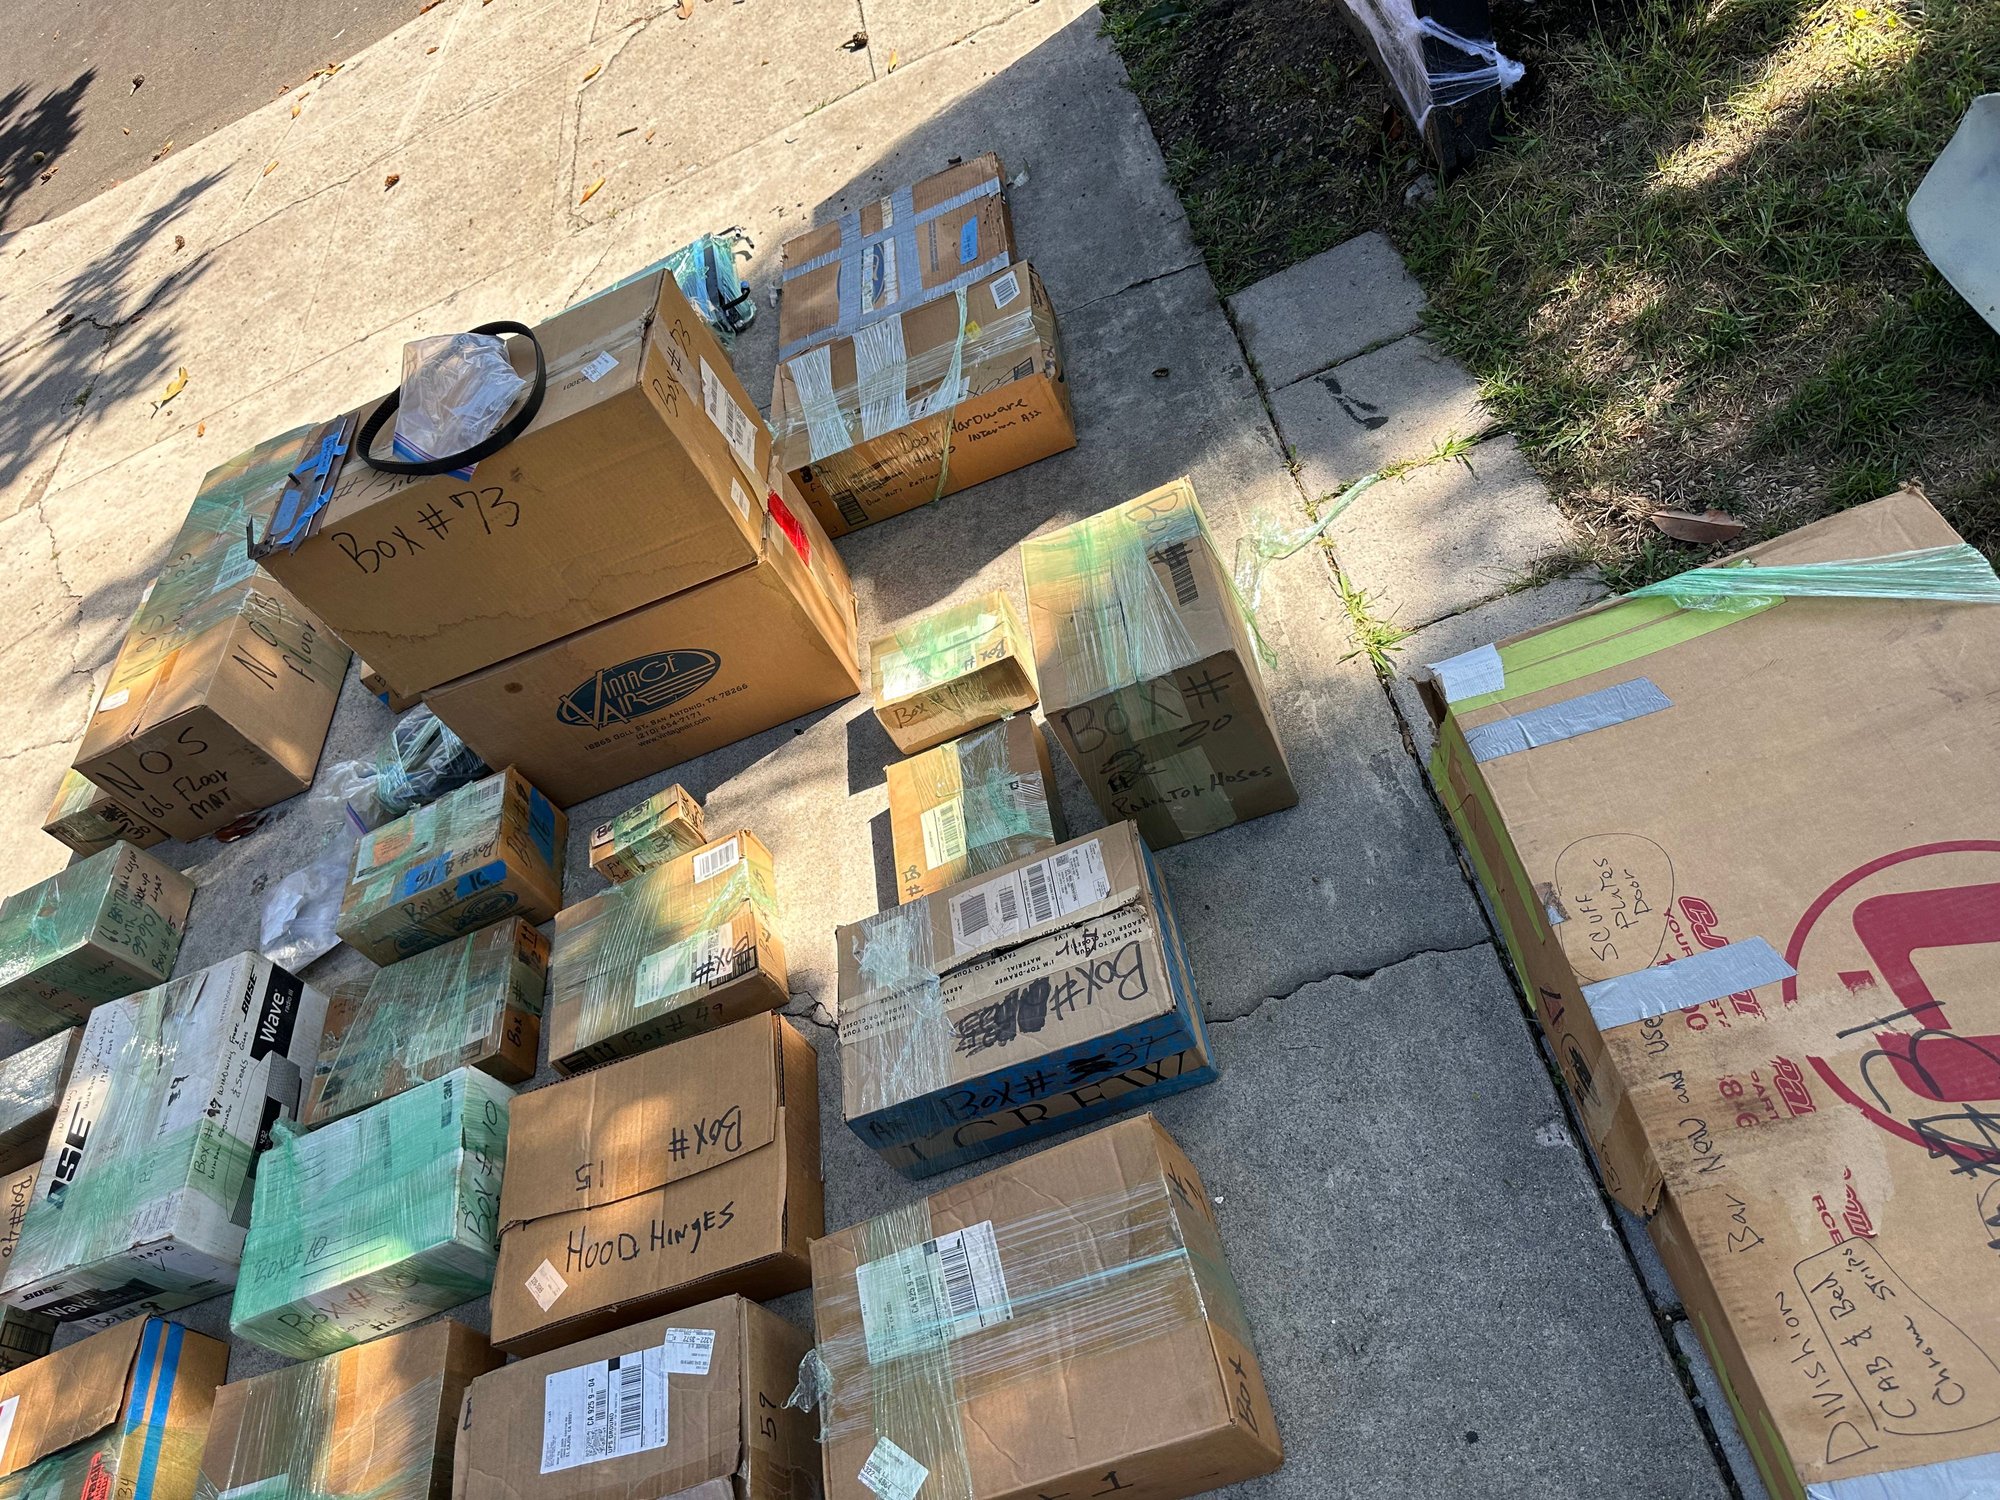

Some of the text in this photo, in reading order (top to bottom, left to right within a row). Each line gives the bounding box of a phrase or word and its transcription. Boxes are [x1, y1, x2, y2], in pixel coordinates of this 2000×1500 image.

[332, 487, 520, 573] Box # 73
[232, 592, 283, 691] NOS
[706, 696, 717, 704] TX
[718, 683, 749, 699] 78266
[1182, 670, 1234, 704] #
[893, 703, 927, 729] Box
[96, 726, 209, 799] NOS
[468, 870, 491, 892] 16
[1074, 941, 1150, 1001] Box
[236, 965, 262, 1022] BOSE
[283, 997, 293, 1013] radio
[260, 991, 289, 1043] Wave
[507, 1016, 524, 1046] Box
[441, 1078, 456, 1100] 3M
[477, 1100, 506, 1135] 10
[668, 1105, 743, 1162] Box #
[193, 1145, 212, 1174] Box
[458, 1179, 507, 1242] Box
[566, 1223, 641, 1274] HOOD
[17, 1280, 70, 1304] BOSE
[42, 1292, 100, 1323] Wave
[587, 1400, 595, 1414] 925
[1231, 1355, 1261, 1437] Box
[587, 1416, 594, 1426] CA
